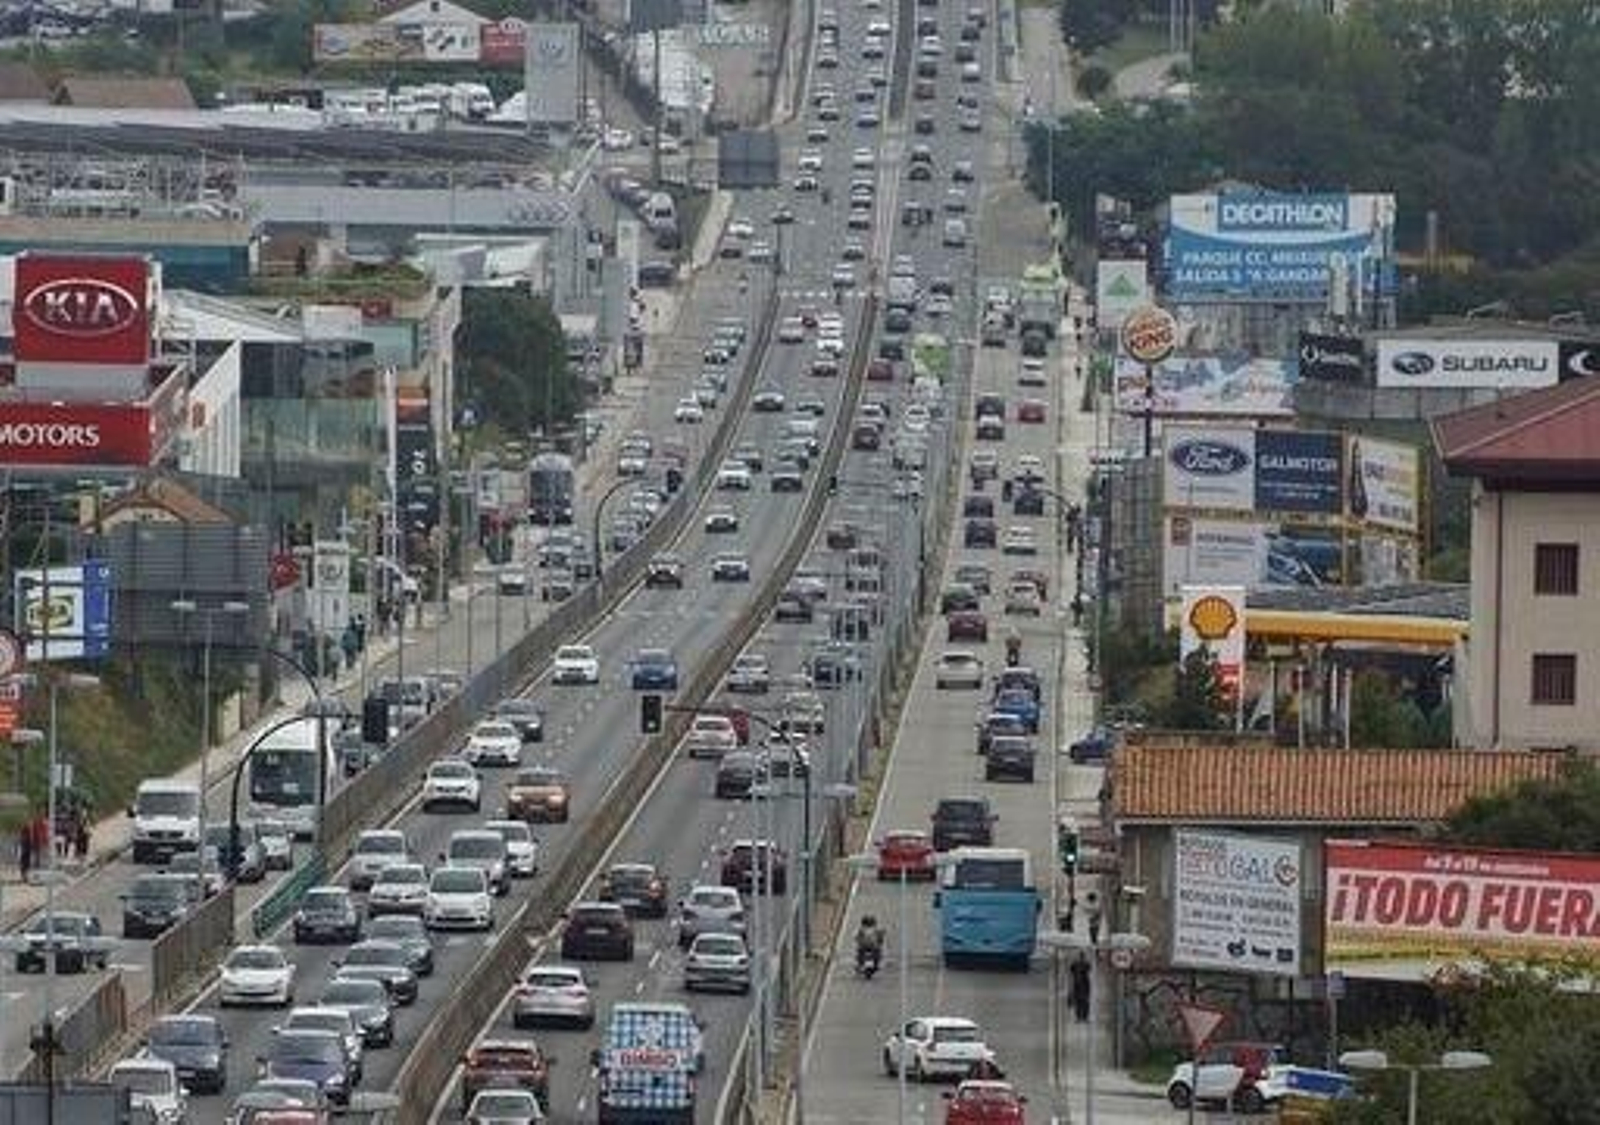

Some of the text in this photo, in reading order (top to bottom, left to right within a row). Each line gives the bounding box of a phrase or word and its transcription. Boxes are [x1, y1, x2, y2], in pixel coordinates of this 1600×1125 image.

[1222, 203, 1344, 225] DECATHLON
[45, 292, 119, 323] KIA
[1129, 328, 1174, 350] KING
[1442, 356, 1548, 372] SUBARU
[1184, 446, 1236, 473] Ford
[1331, 874, 1600, 937] ¡TODO FUER
[620, 1050, 678, 1069] BIMBO
